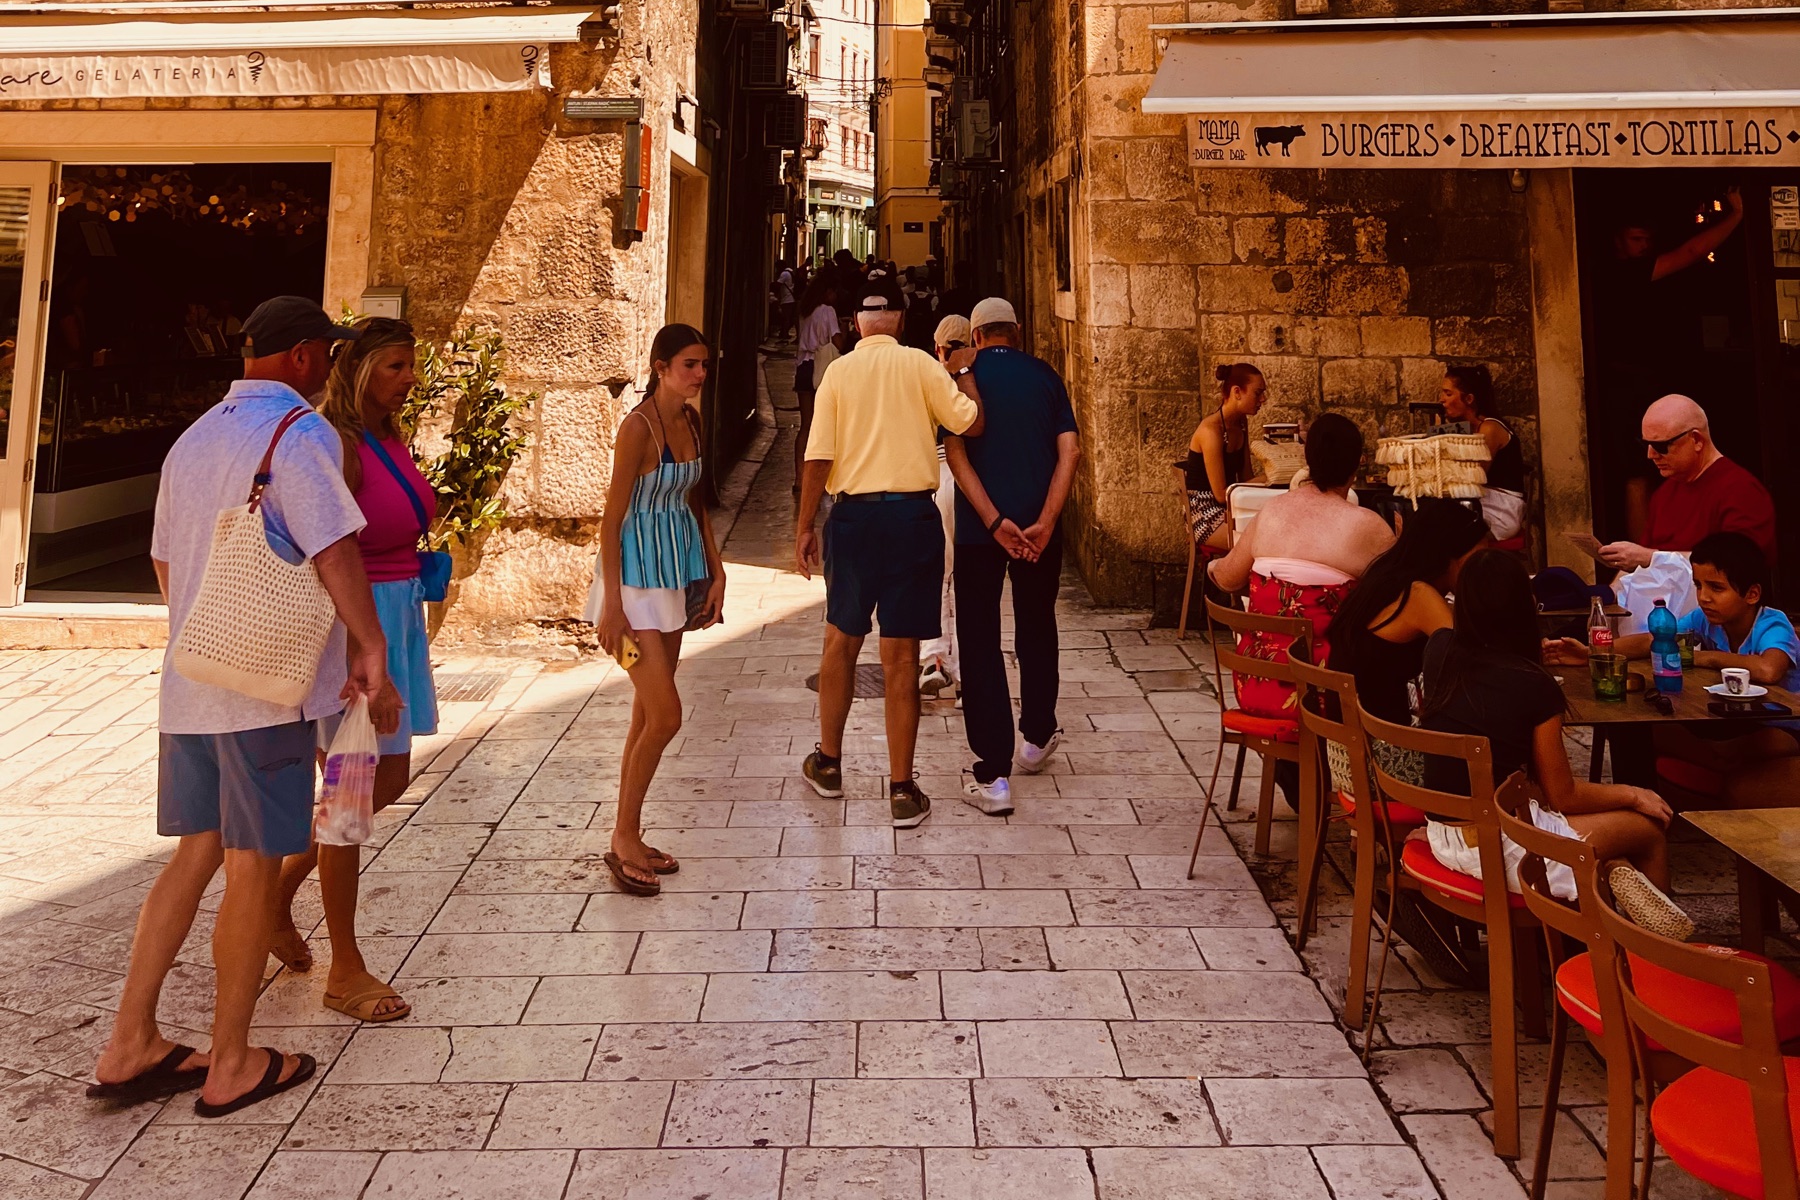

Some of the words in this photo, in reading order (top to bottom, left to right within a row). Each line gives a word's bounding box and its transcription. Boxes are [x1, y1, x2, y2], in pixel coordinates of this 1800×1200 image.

[0, 70, 63, 93] are
[75, 67, 237, 82] GELATERIA
[1198, 119, 1241, 141] MAMA
[1321, 123, 1439, 157] BURGERS
[1460, 121, 1611, 157] BREAKFAST
[1627, 119, 1783, 156] TORTILLAS
